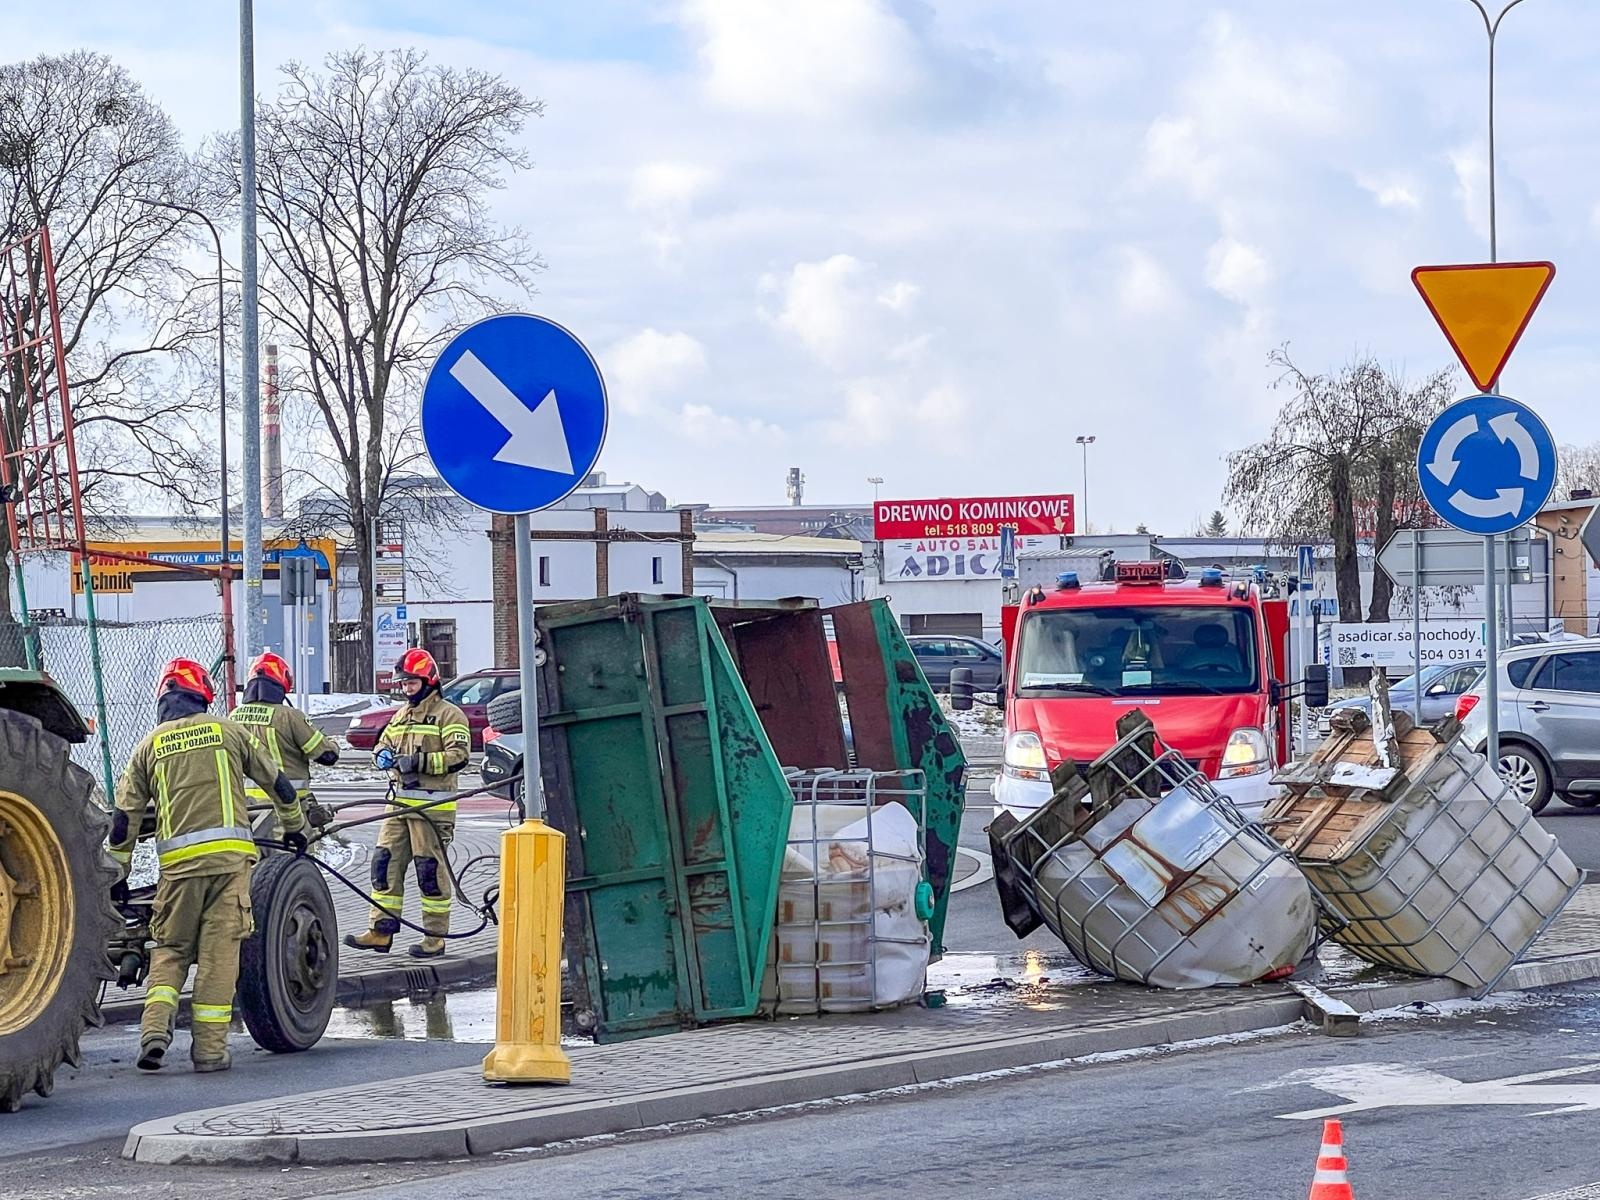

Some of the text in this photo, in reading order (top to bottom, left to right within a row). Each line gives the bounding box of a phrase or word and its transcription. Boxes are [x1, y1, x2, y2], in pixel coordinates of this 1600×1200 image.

[879, 499, 1070, 523] DREWNO KOMINKOWE
[925, 525, 944, 538] tel.
[946, 524, 968, 536] 518
[971, 522, 994, 534] 809
[916, 538, 1023, 552] AUTO SALN
[73, 572, 133, 590] Tchnik
[1420, 648, 1487, 660] 504 031 4
[160, 725, 213, 745] PAŃSTWOWA
[156, 735, 221, 757] STRAŻ POŻARNA
